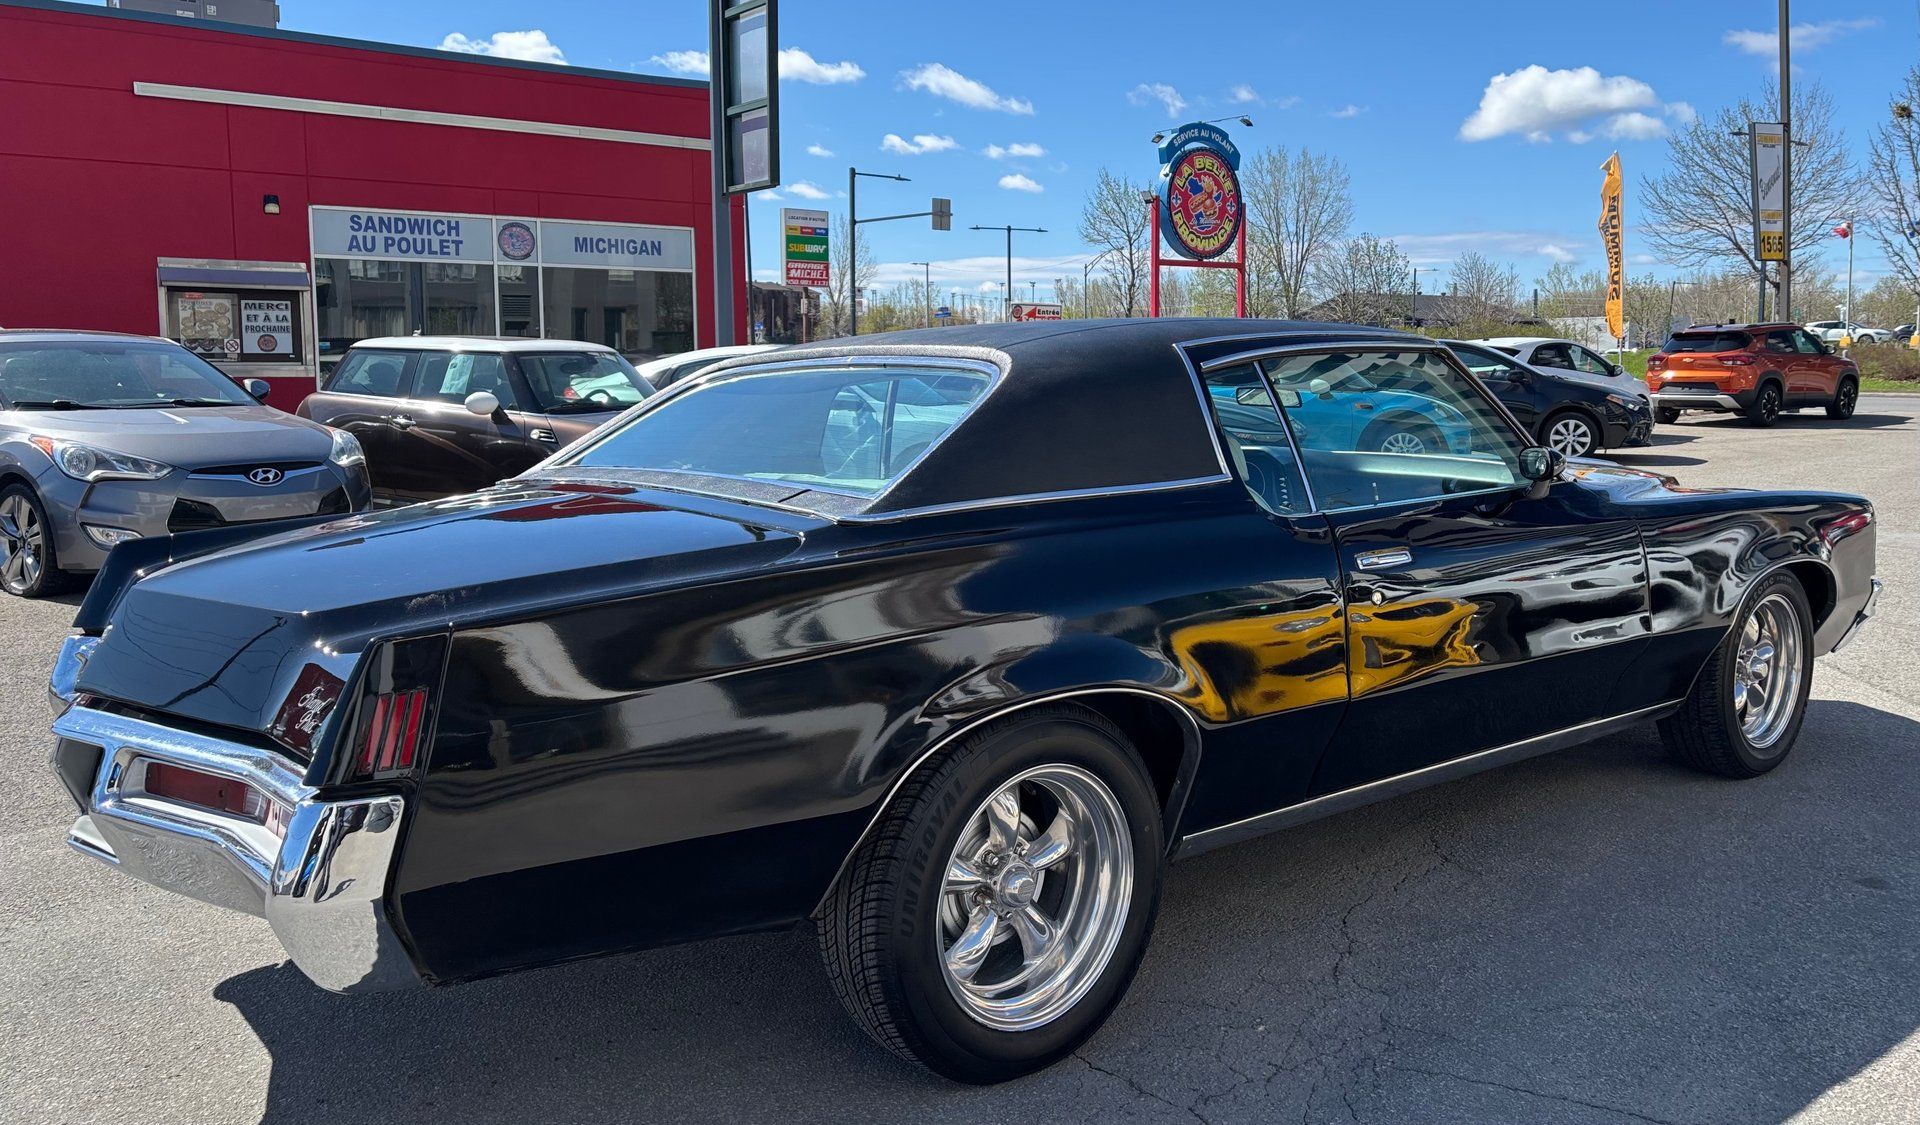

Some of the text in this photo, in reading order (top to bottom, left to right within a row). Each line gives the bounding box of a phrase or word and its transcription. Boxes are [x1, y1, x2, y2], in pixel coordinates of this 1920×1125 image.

[1173, 128, 1234, 154] SERVICE AU VOLANT
[1175, 156, 1234, 197] LA BELLE
[349, 214, 461, 238] SANDWICH
[1172, 208, 1235, 250] PROVINCE
[347, 234, 464, 257] AU POULET
[574, 236, 662, 257] MICHIGAN
[788, 243, 827, 253] SUBWAY
[1761, 234, 1783, 253] 1565
[790, 270, 828, 278] MICHEL
[243, 302, 290, 311] MERCI
[246, 312, 289, 323] ET À LA
[245, 324, 291, 334] PROCHAINE
[902, 777, 967, 937] UNIROYAL
